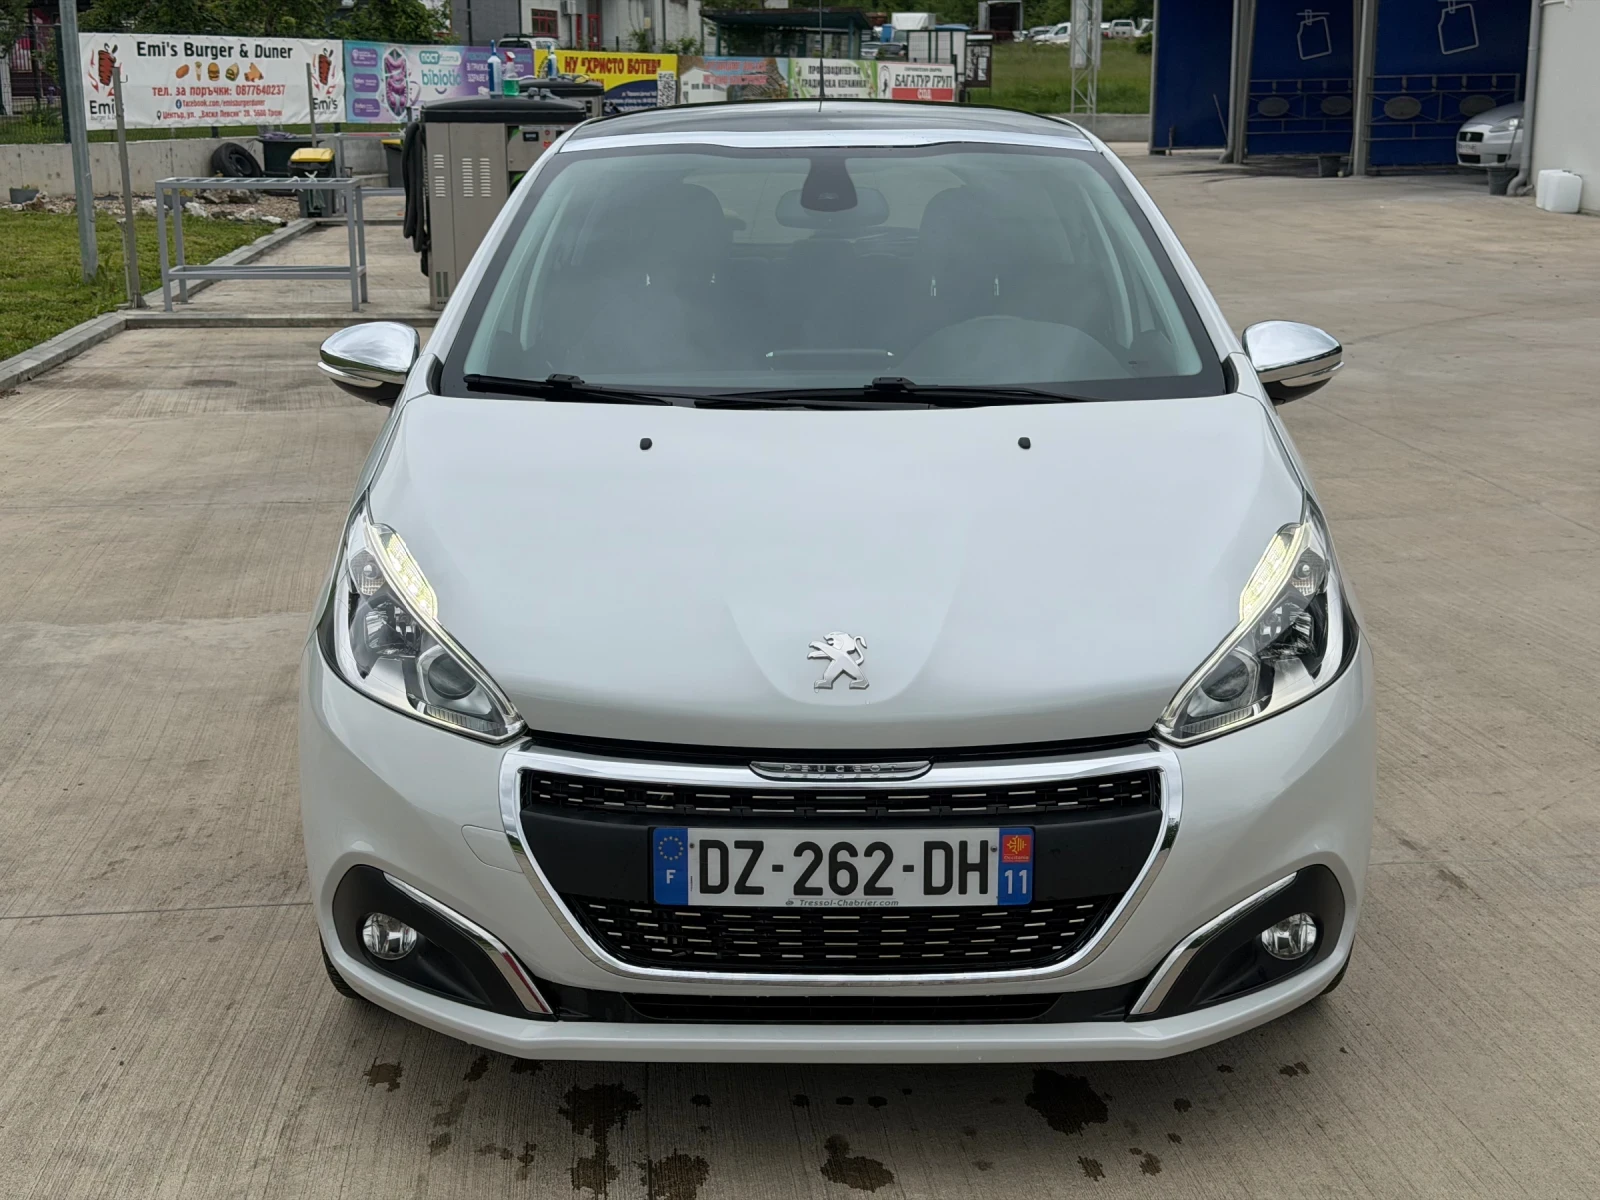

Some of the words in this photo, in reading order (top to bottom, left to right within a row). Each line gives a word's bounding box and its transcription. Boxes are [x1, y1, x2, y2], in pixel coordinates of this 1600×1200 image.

[136, 41, 178, 57] Emi's
[184, 42, 234, 60] Burger
[239, 43, 249, 58] &
[254, 44, 293, 59] Duner
[564, 56, 578, 74] НУ
[808, 65, 851, 76] ПРОЗВОДИТЕЛ
[421, 69, 461, 86] bibiotic
[801, 79, 836, 89] ГРАДИСКА
[894, 74, 931, 87] БАГАТУР
[931, 75, 953, 88] ГРУП
[152, 87, 172, 97] тел.
[176, 87, 186, 96] за
[190, 86, 232, 98] поръчки:
[236, 84, 285, 97] 0877640237
[312, 96, 338, 111] Emi's
[782, 763, 898, 773] PEUGEOT
[698, 838, 989, 896] DZ-262-DH
[666, 869, 676, 884] F
[1004, 869, 1027, 895] 11
[799, 898, 899, 908] Tressol-Chabrier.com
